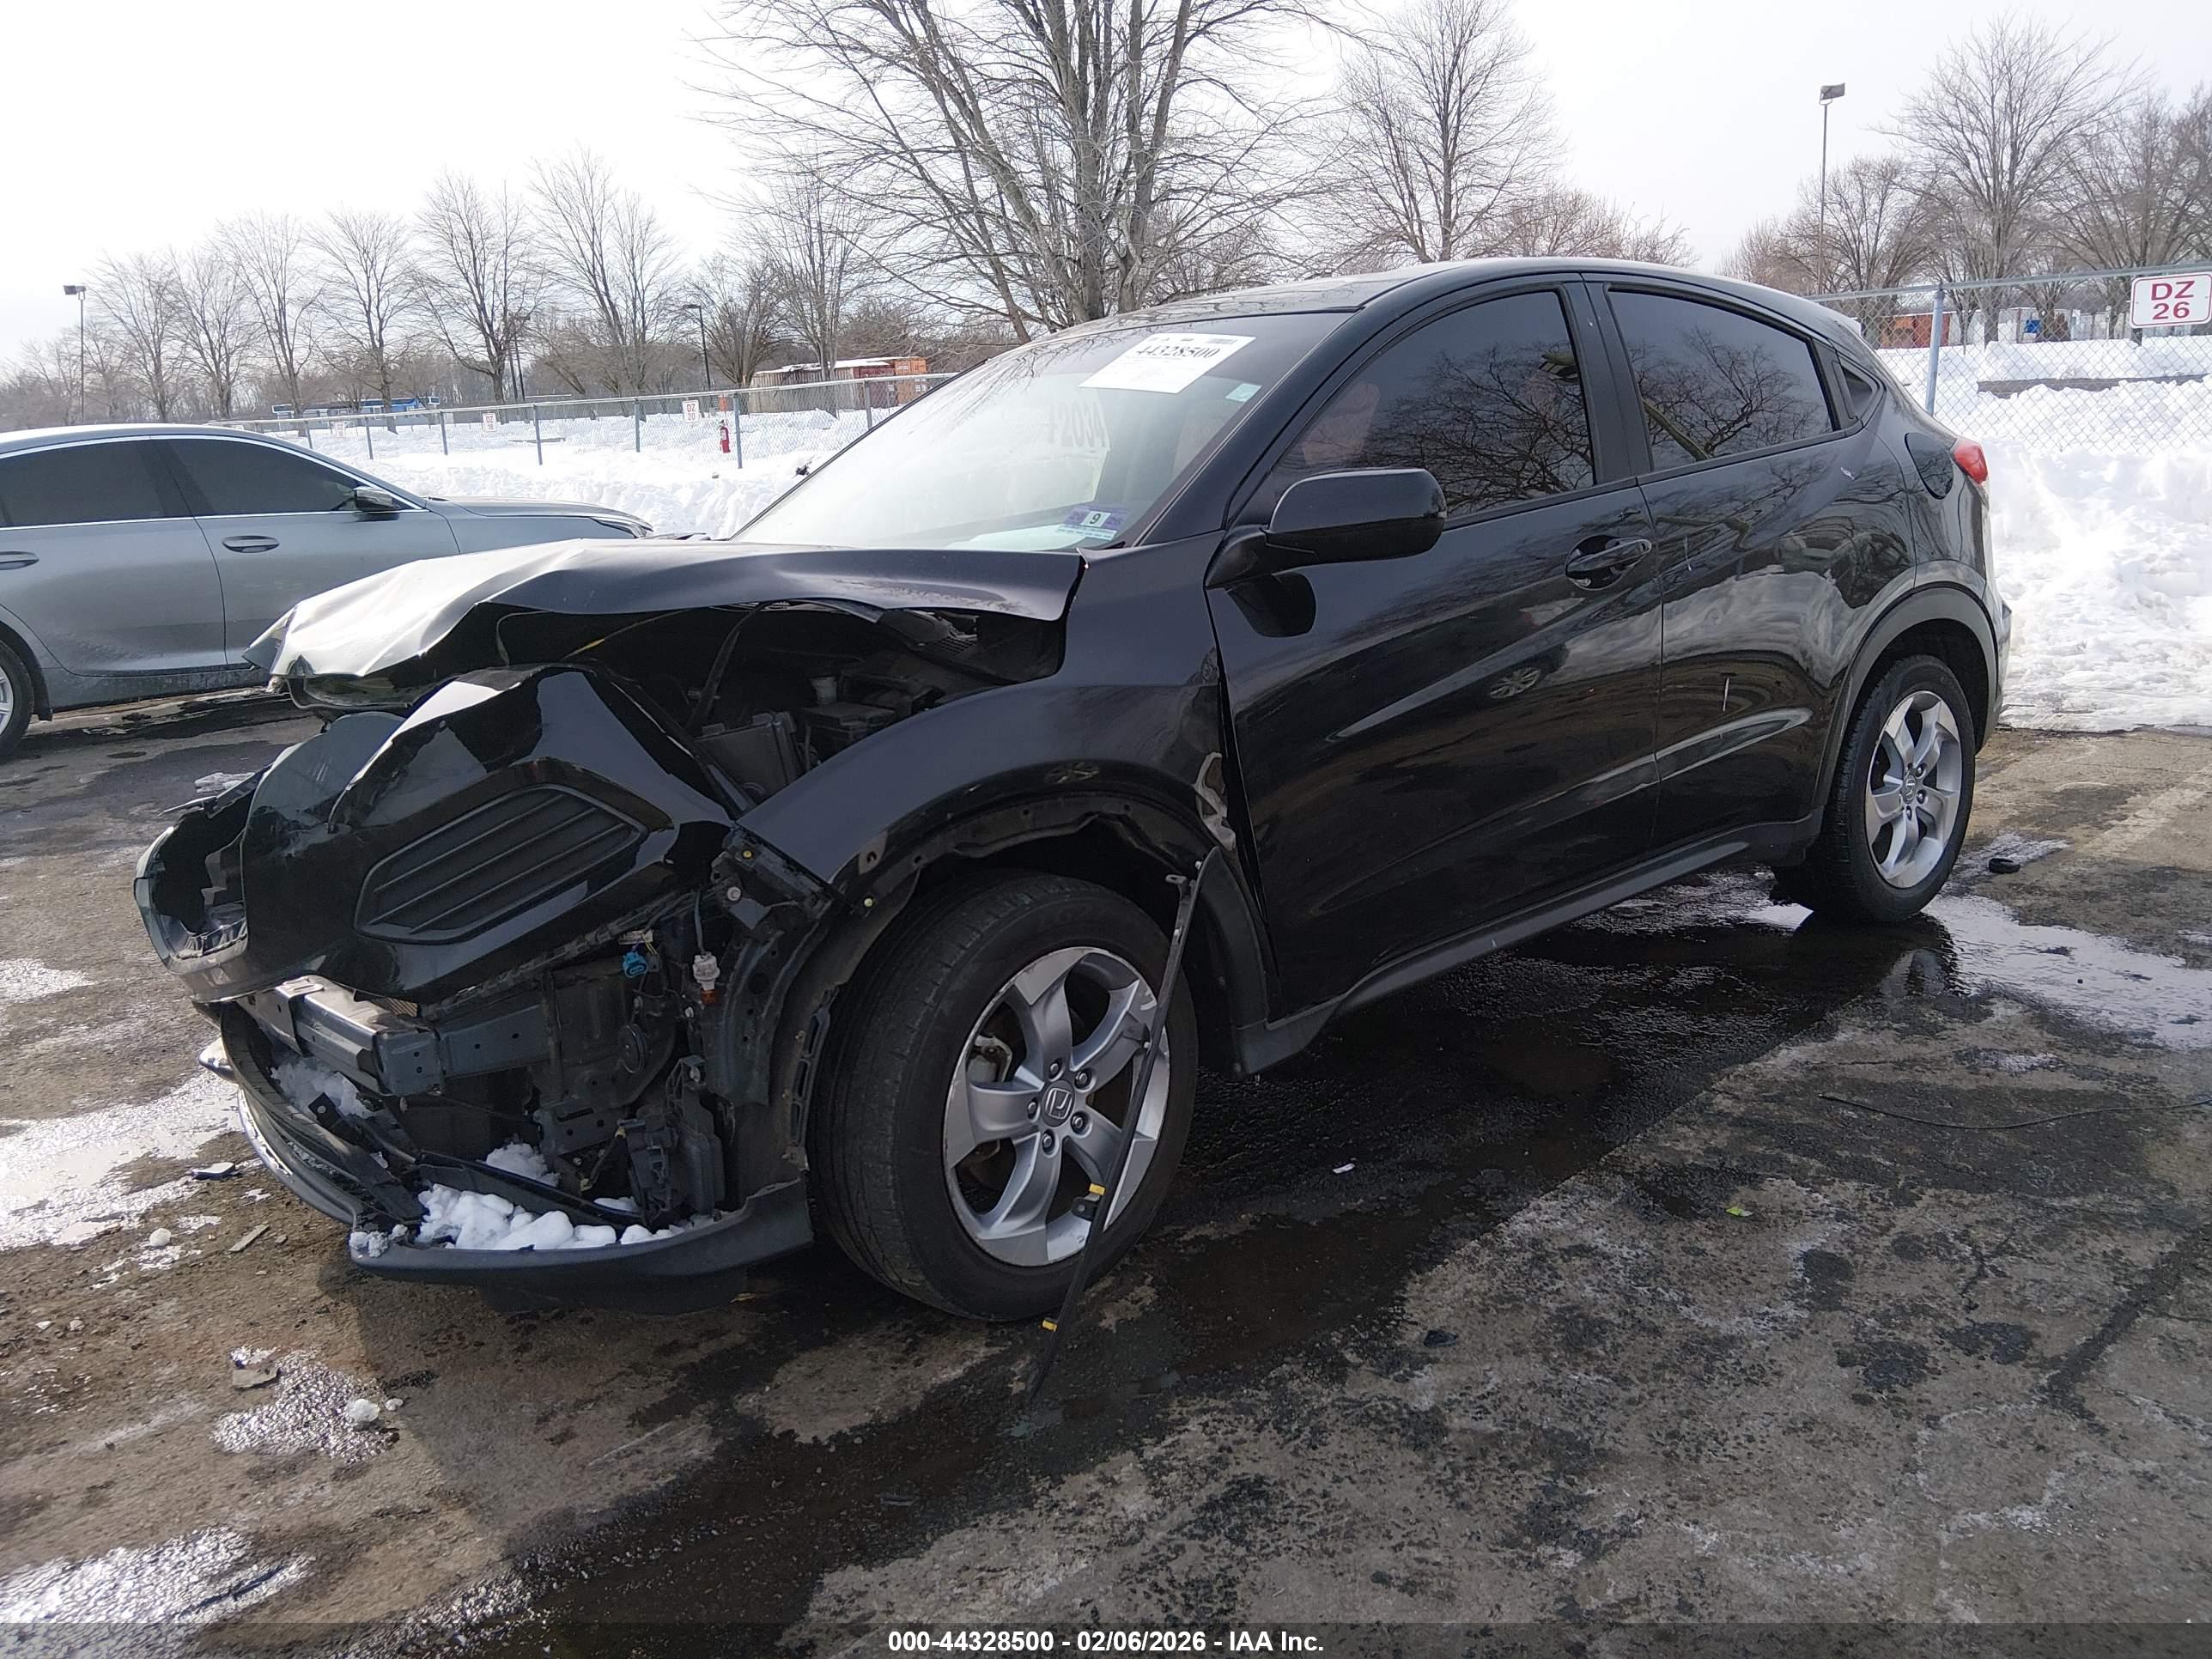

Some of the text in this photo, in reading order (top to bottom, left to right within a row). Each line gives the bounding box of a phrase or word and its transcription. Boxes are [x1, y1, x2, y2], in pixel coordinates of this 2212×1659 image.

[2151, 281, 2195, 301] DZ
[2152, 301, 2190, 319] 26
[687, 404, 696, 412] DZ
[1090, 513, 1102, 525] 9
